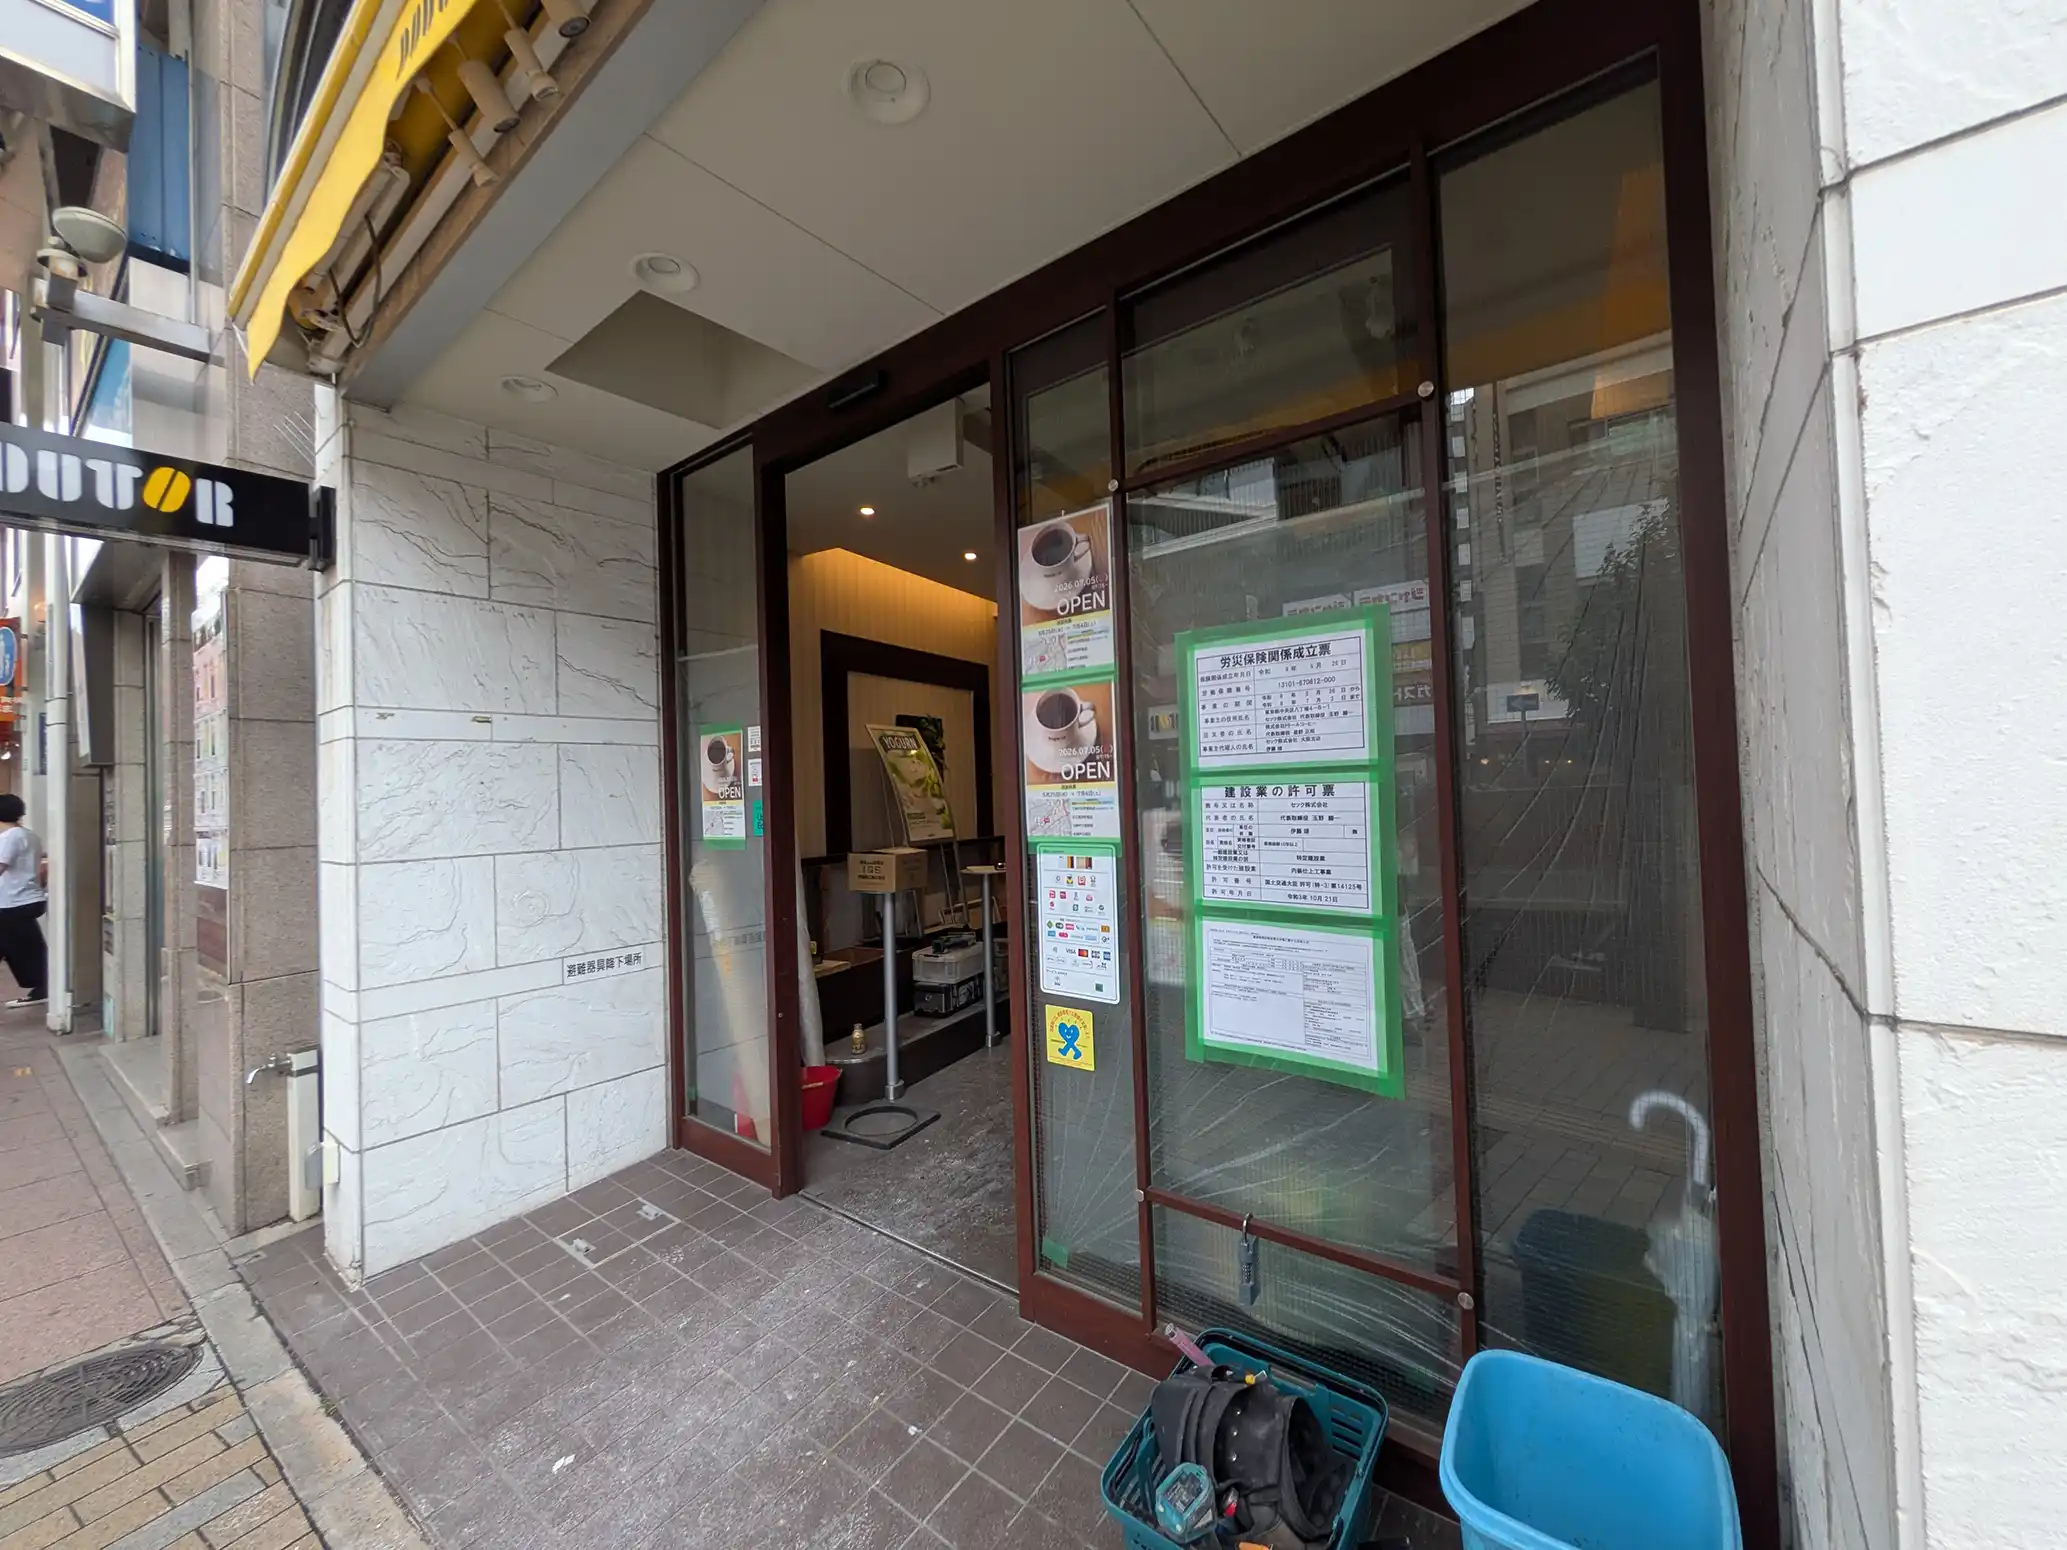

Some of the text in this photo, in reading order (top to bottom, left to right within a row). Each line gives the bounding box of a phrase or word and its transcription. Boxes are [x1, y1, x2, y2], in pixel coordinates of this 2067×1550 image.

[1057, 591, 1105, 615] OPEN
[1221, 643, 1332, 669] 労災保険関係成立票
[1061, 762, 1110, 780] OPEN
[718, 786, 741, 799] OPEN
[1224, 784, 1335, 798] 建設業の許可票
[567, 952, 641, 978] 避難器具降下場所
